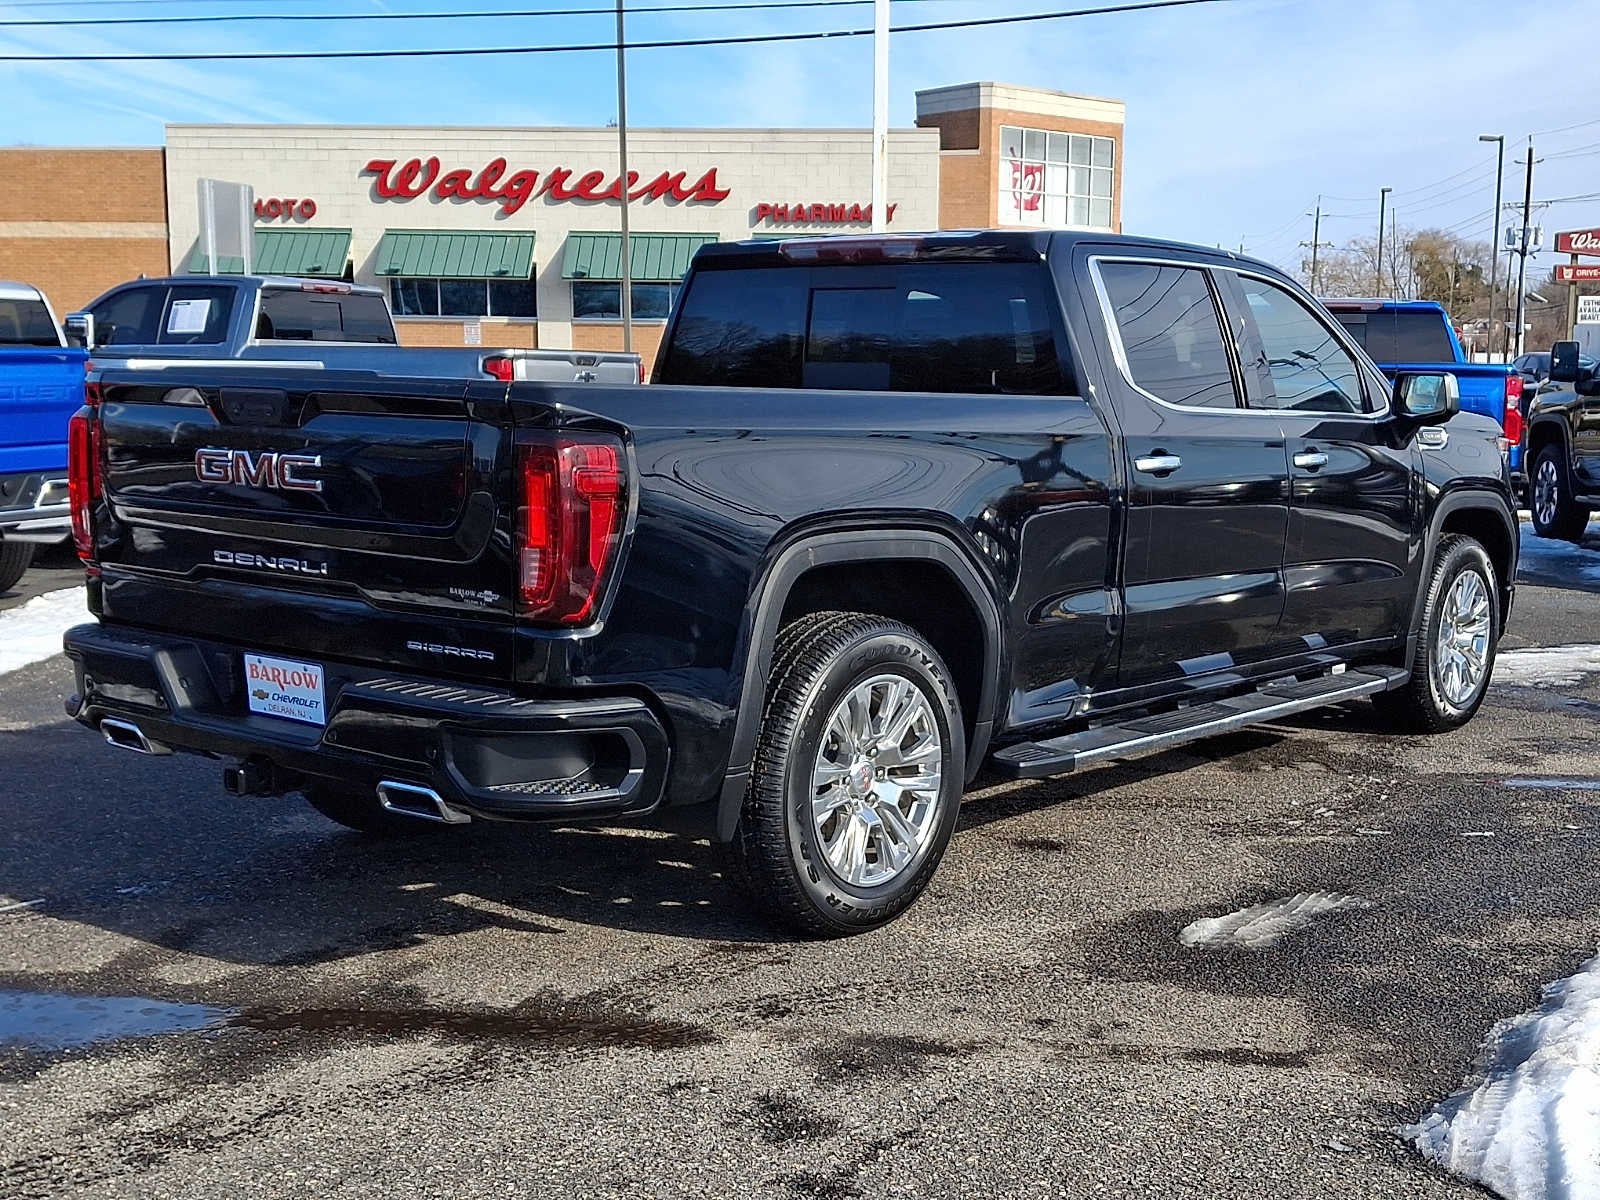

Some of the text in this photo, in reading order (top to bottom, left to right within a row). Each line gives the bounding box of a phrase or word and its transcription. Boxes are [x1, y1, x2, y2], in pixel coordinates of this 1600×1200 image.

[366, 156, 731, 215] Walgreens
[254, 198, 316, 219] HOTO
[195, 448, 322, 492] GMC
[213, 549, 328, 575] DENALI
[407, 640, 494, 660] SIERRA
[248, 662, 318, 692] BARLOW
[271, 692, 320, 709] CHEVROLET
